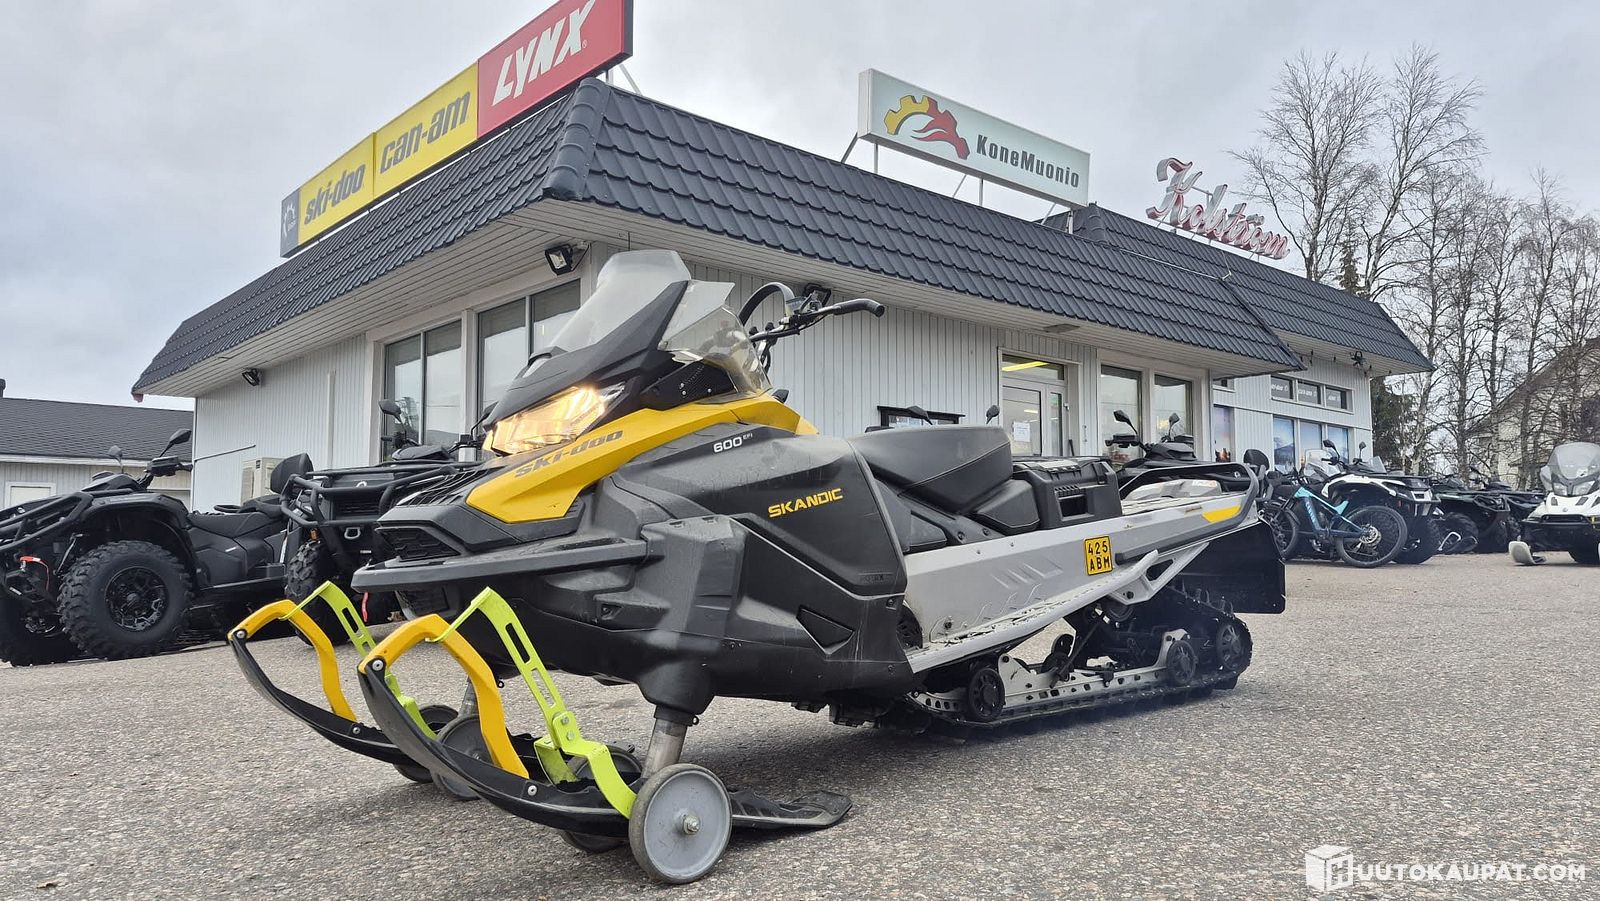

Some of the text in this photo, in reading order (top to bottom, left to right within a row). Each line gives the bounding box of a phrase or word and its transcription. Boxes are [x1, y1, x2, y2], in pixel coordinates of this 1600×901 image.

[492, 0, 596, 107] LYNX
[380, 91, 471, 175] can-am
[976, 134, 1080, 188] KoneMuonio
[303, 163, 367, 225] ski-doo
[713, 436, 743, 453] 600
[768, 488, 844, 518] SKANDIC
[1088, 541, 1108, 555] 425
[1090, 556, 1110, 571] ABM
